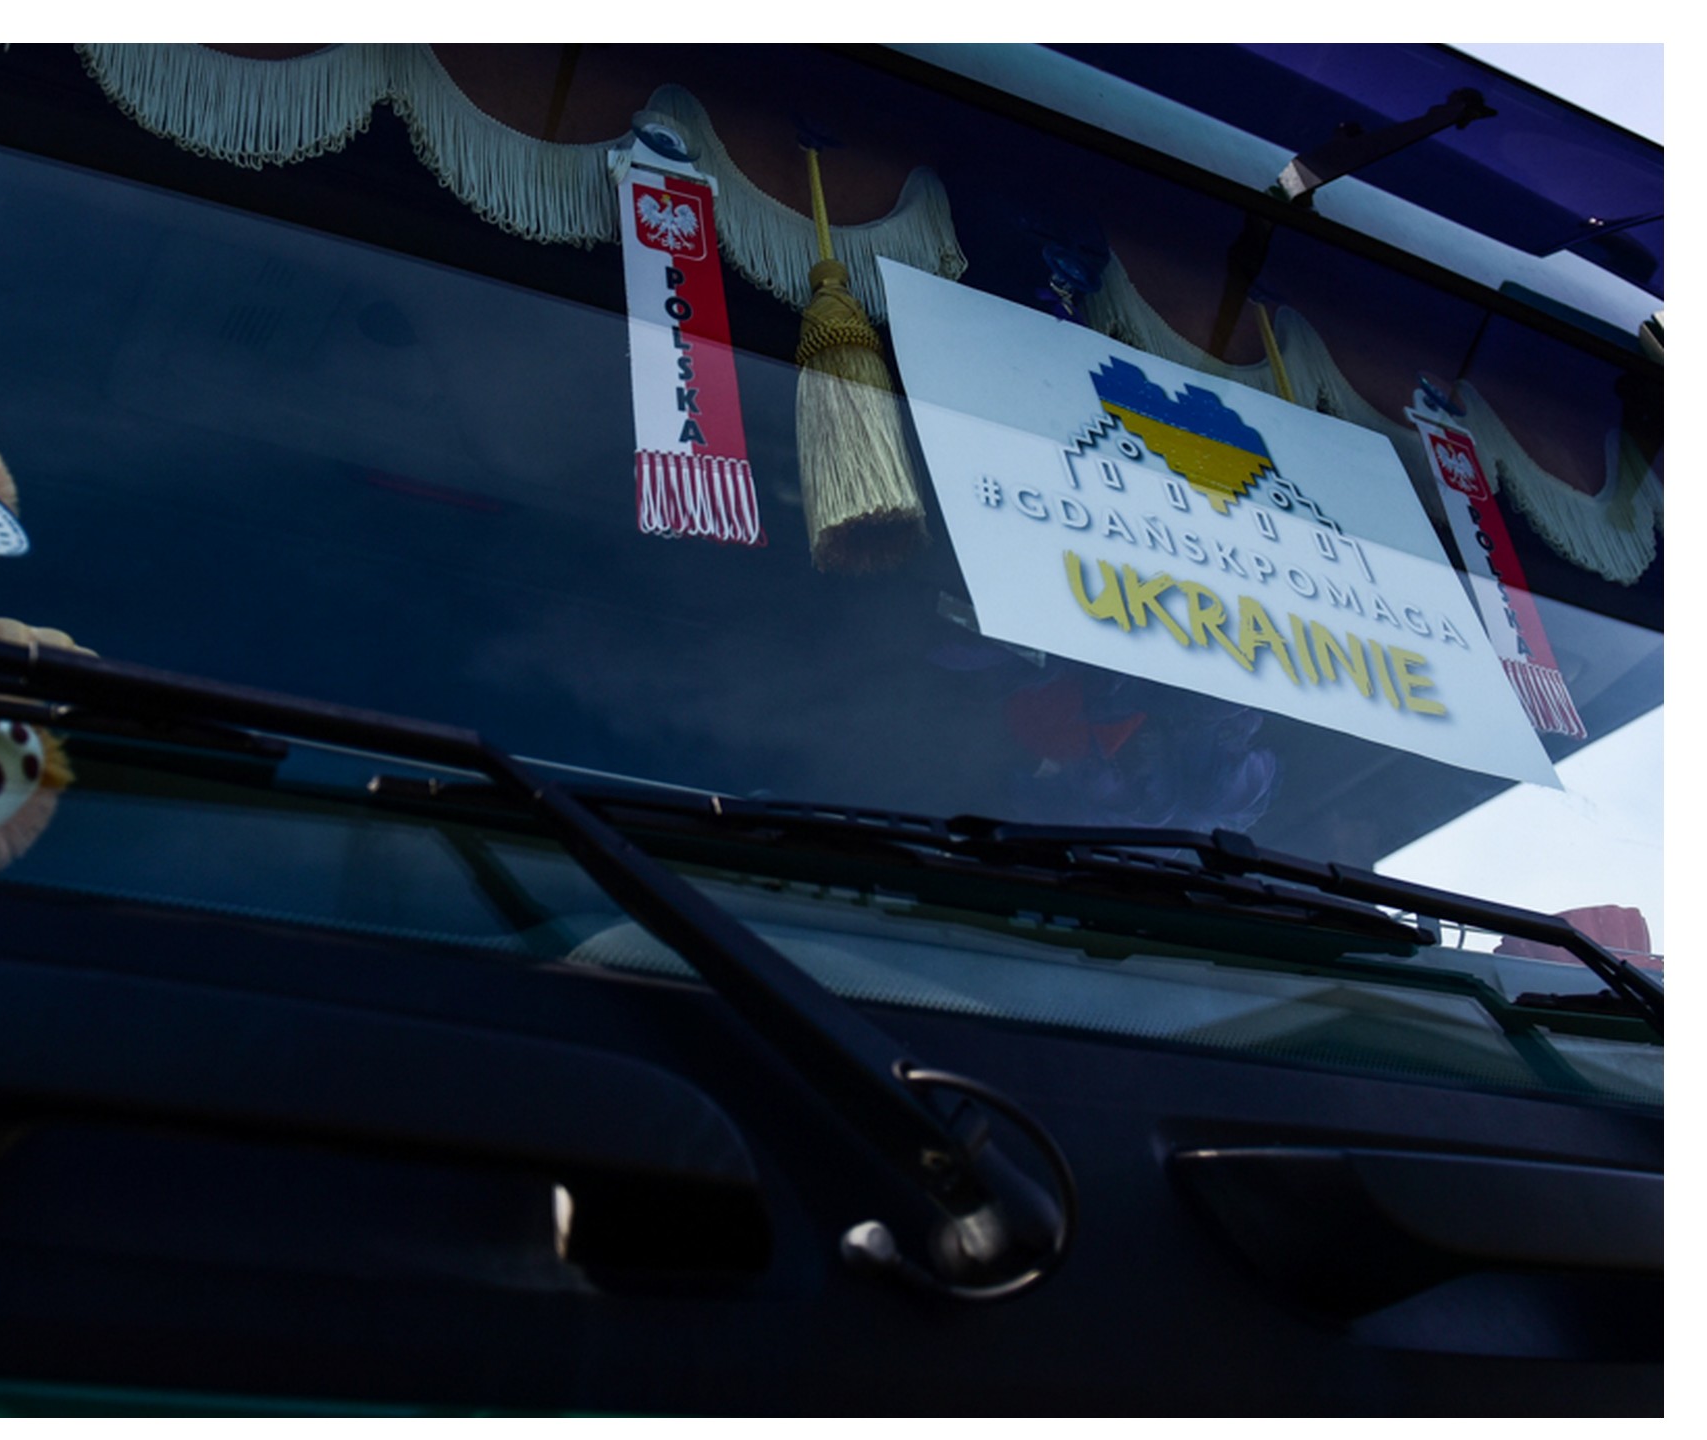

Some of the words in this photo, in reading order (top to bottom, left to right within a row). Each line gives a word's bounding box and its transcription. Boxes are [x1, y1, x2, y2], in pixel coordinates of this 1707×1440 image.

[665, 266, 707, 446] POLSKA
[974, 476, 1469, 650] #GDAŃSKPOMAGA
[1062, 548, 1448, 716] UKRAINIE
[1467, 504, 1535, 660] POLSKA
